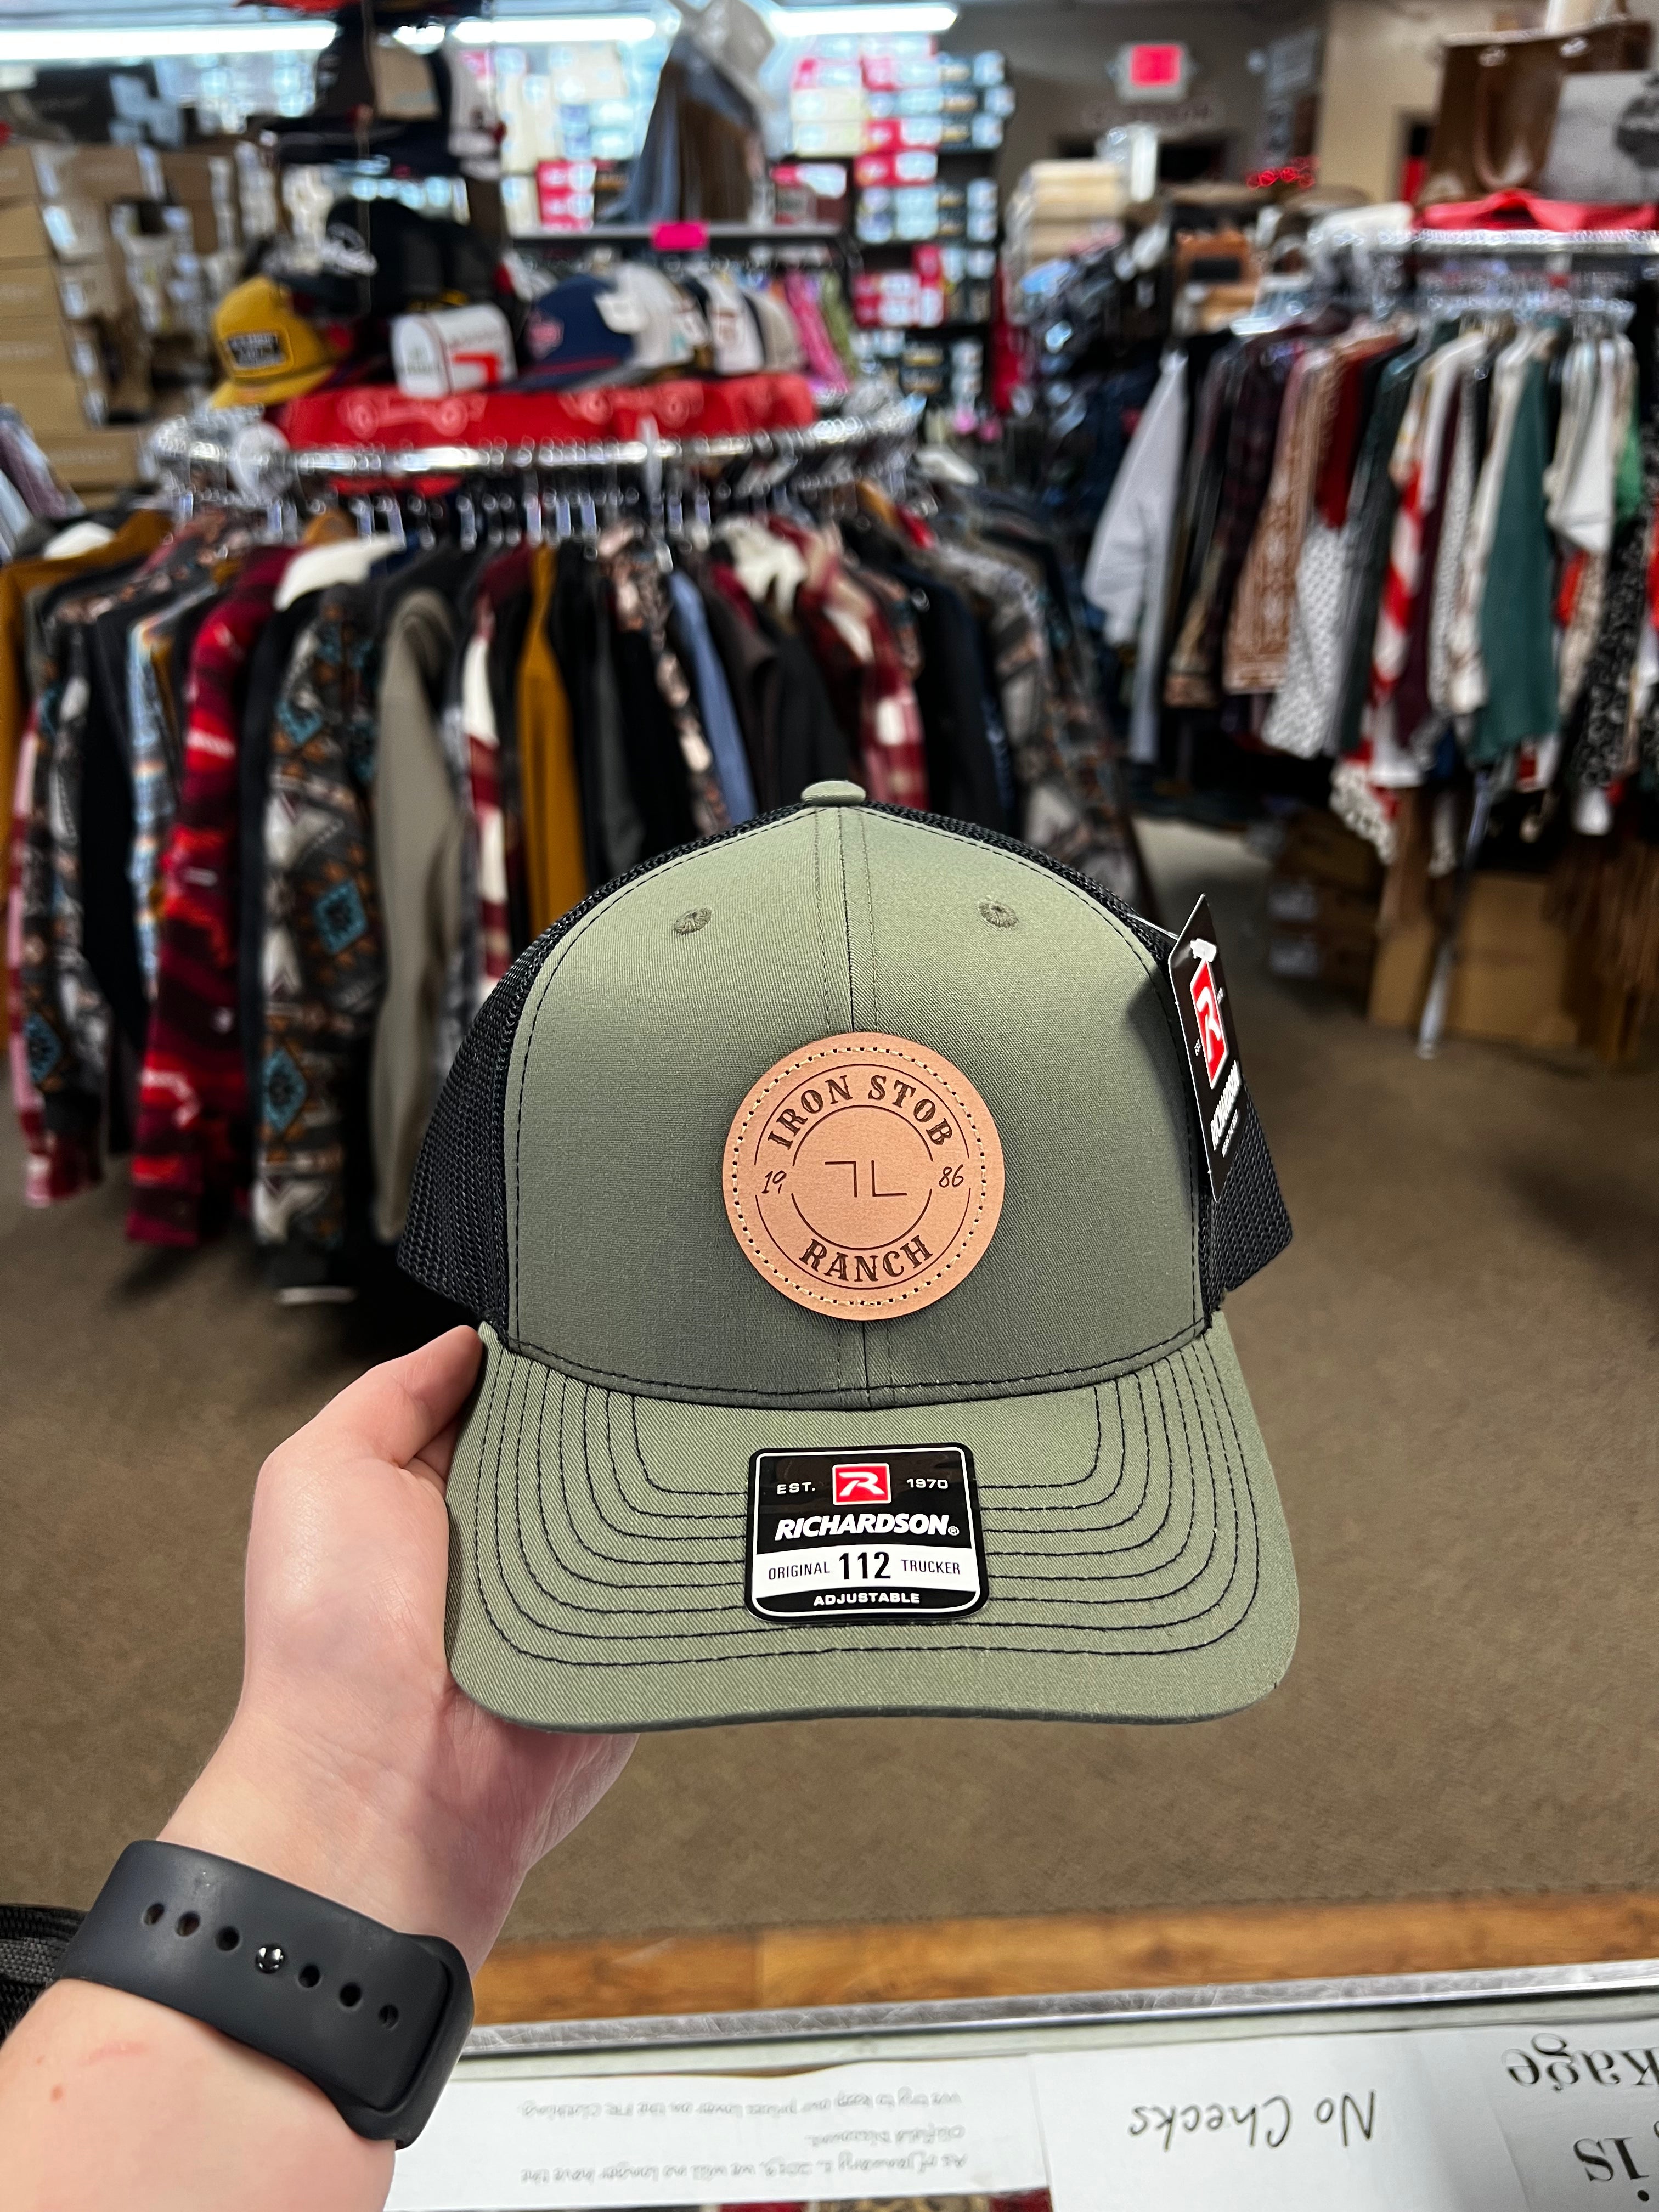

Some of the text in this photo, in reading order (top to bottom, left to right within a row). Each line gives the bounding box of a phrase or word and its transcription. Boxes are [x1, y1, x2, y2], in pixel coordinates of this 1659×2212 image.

[767, 1075, 953, 1150] IRON STOB
[761, 1164, 964, 1194] 19 86
[798, 1234, 933, 1282] RANCH
[776, 1478, 949, 1495] EST. 1970
[768, 1551, 961, 1581] ORIGINAL 112 TRUCKER
[813, 1592, 921, 1607] ADJUSTABLE
[1128, 2089, 1378, 2152] No Checks
[1573, 2137, 1650, 2202] is
